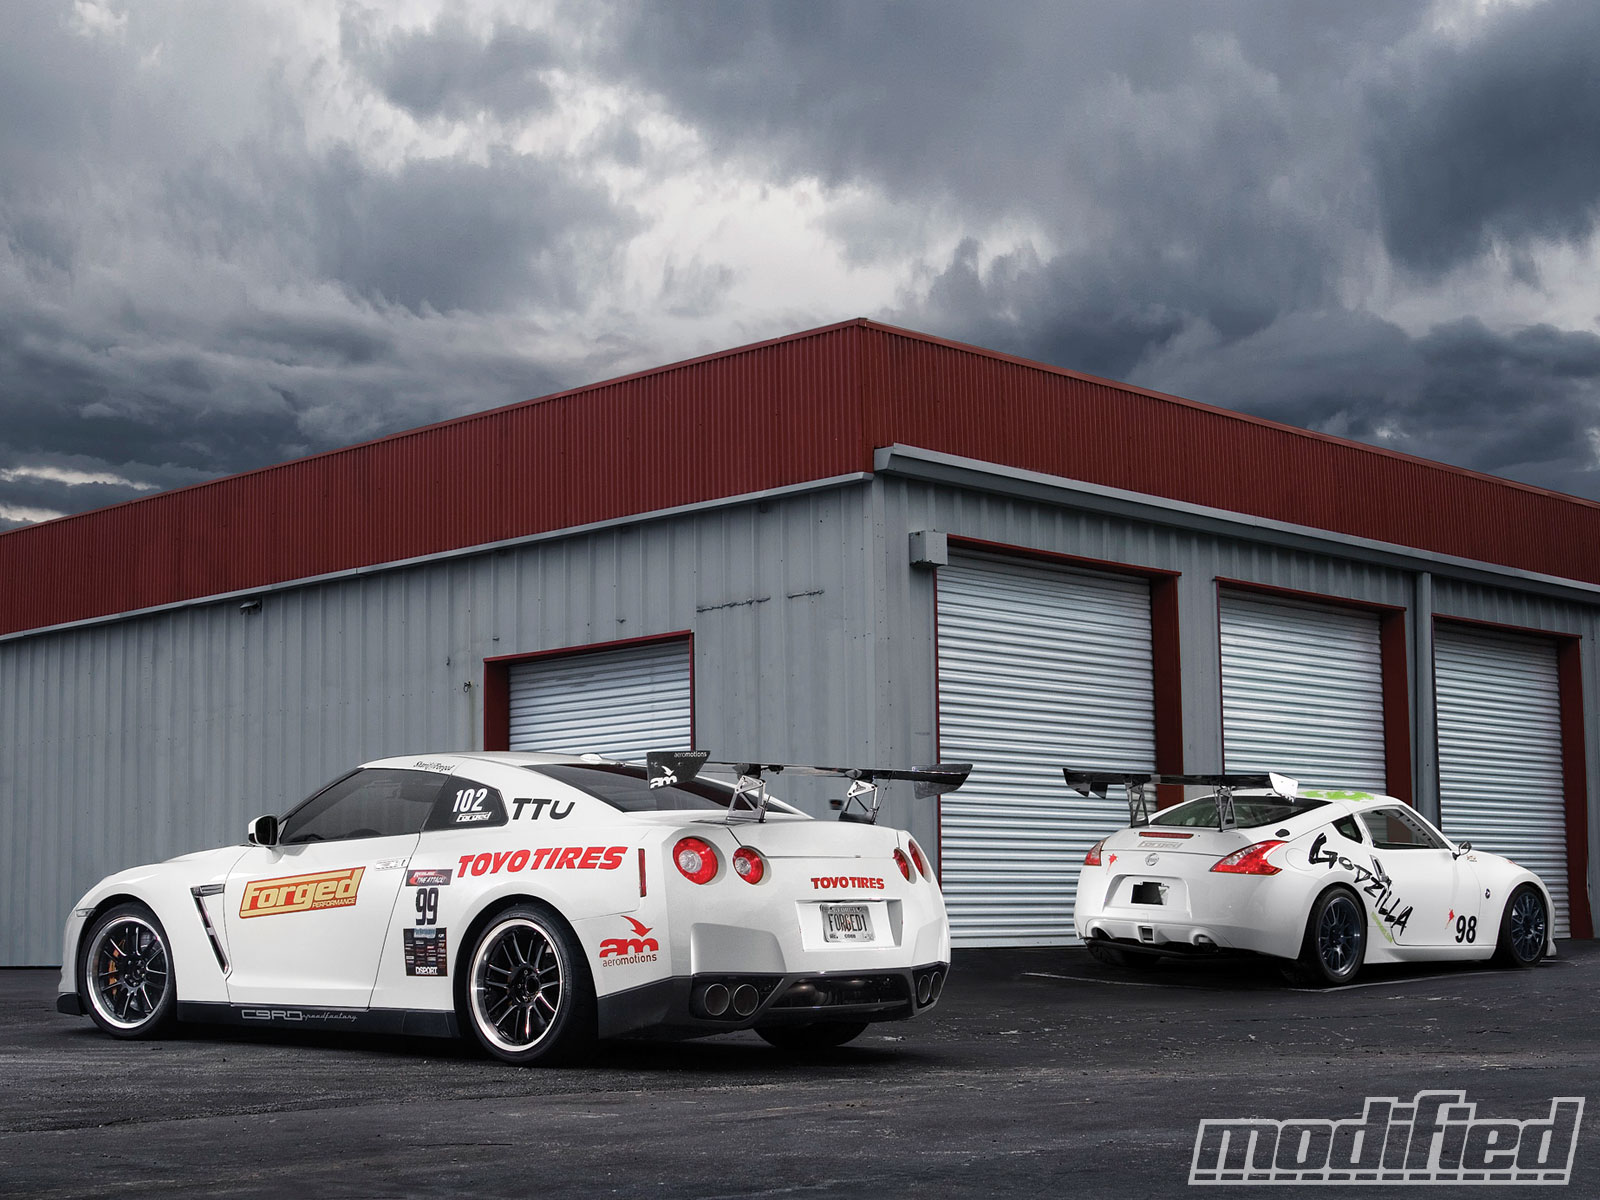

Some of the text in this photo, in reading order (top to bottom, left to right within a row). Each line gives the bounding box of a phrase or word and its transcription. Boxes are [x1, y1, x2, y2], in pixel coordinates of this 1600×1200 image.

[452, 788, 488, 812] 102
[512, 797, 575, 820] TTU
[240, 868, 364, 917] Forged
[312, 897, 356, 908] PERFORMANCE
[416, 888, 439, 925] 99
[828, 913, 867, 931] FORGED1
[1455, 915, 1477, 943] 98
[599, 938, 659, 958] am
[415, 966, 438, 975] DSPORT
[603, 953, 657, 967] aeromotions
